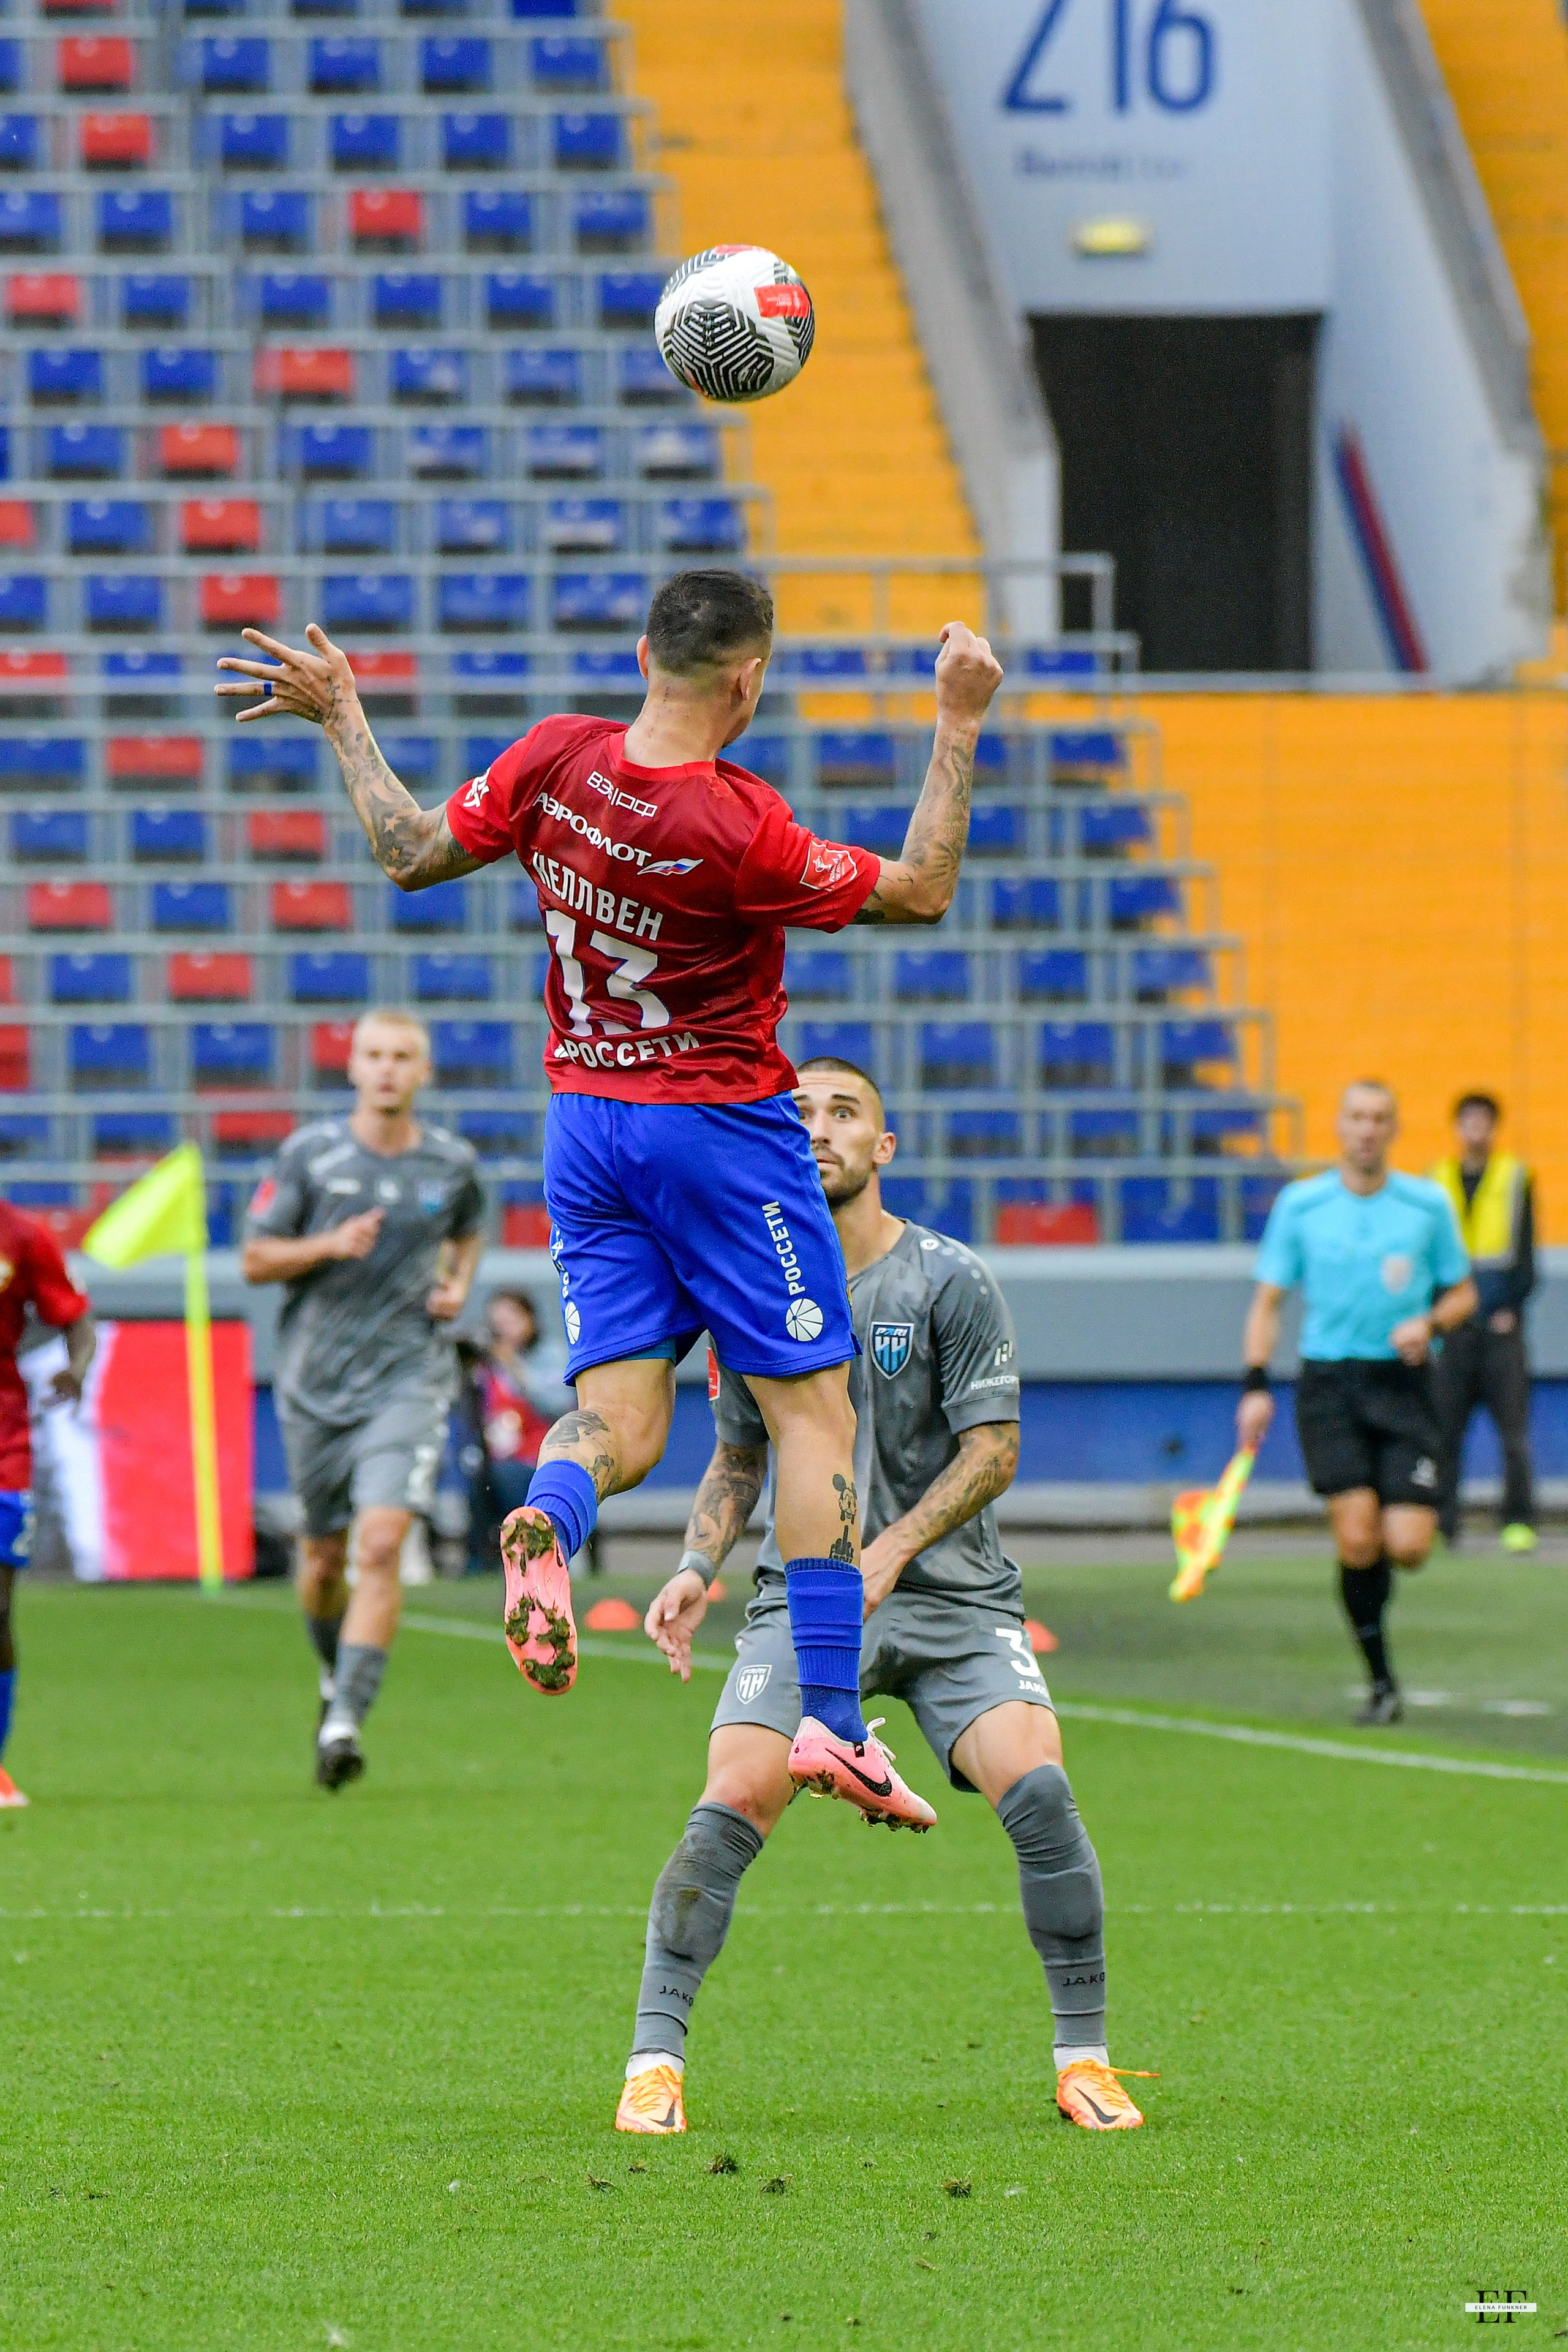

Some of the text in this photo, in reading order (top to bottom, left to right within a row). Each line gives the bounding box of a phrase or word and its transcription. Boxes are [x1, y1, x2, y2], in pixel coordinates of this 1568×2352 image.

[532, 792, 652, 867] АЭРОФЛОТ
[545, 910, 672, 1037] 13
[564, 1031, 700, 1068] РОССЕТИ
[761, 1201, 805, 1295] РОССЕТИ
[875, 1327, 908, 1336] PARI
[995, 1627, 1041, 1677] 3
